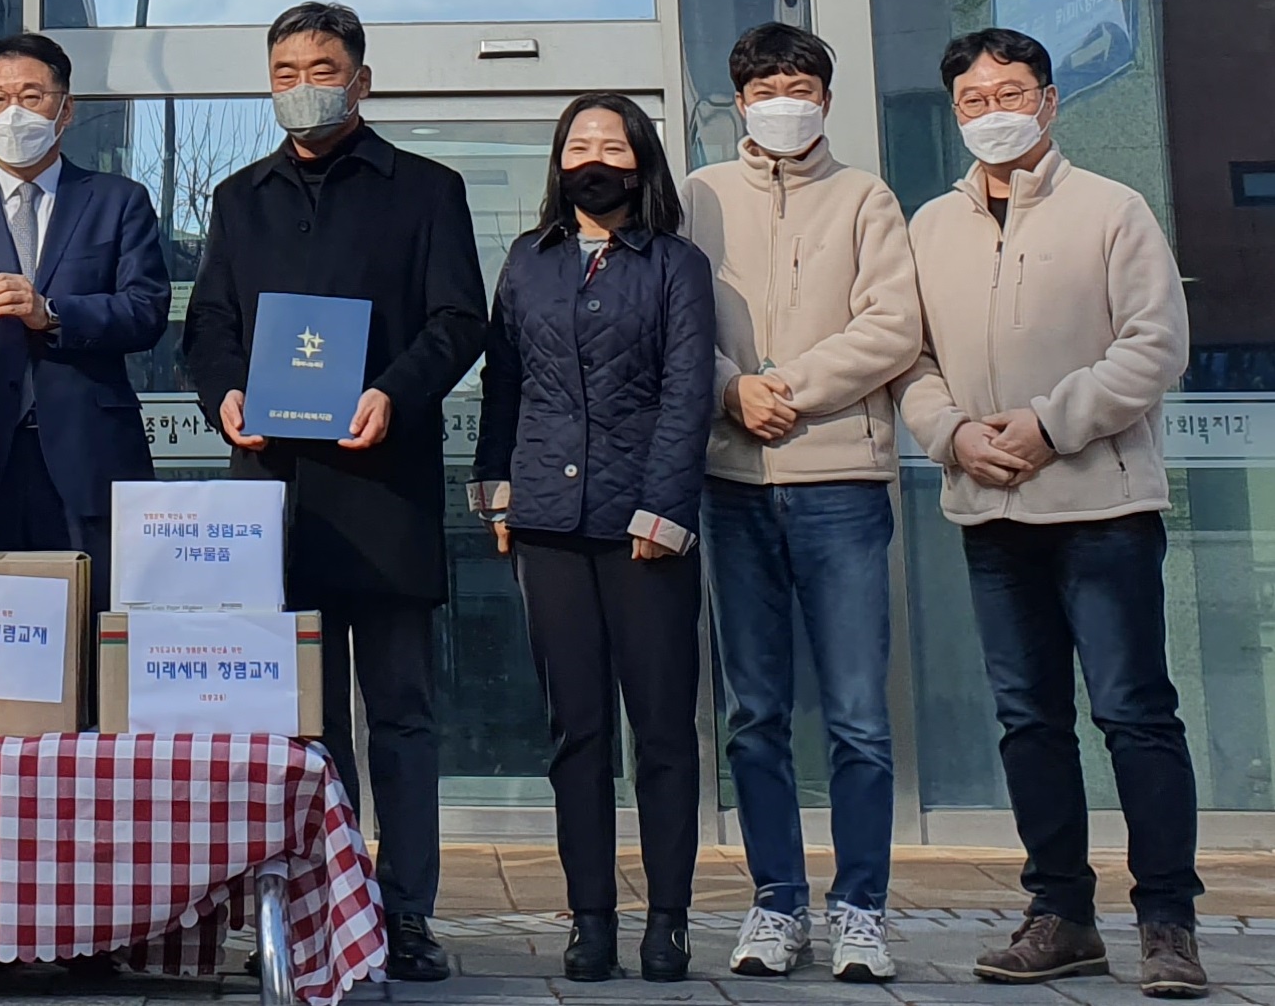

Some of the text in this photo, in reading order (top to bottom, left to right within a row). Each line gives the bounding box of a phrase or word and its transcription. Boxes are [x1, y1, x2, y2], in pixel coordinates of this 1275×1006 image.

[143, 523, 263, 538] 미래세대 청렴교육
[175, 546, 230, 562] 기부물품
[147, 661, 279, 680] 미래세대 청렴교재
